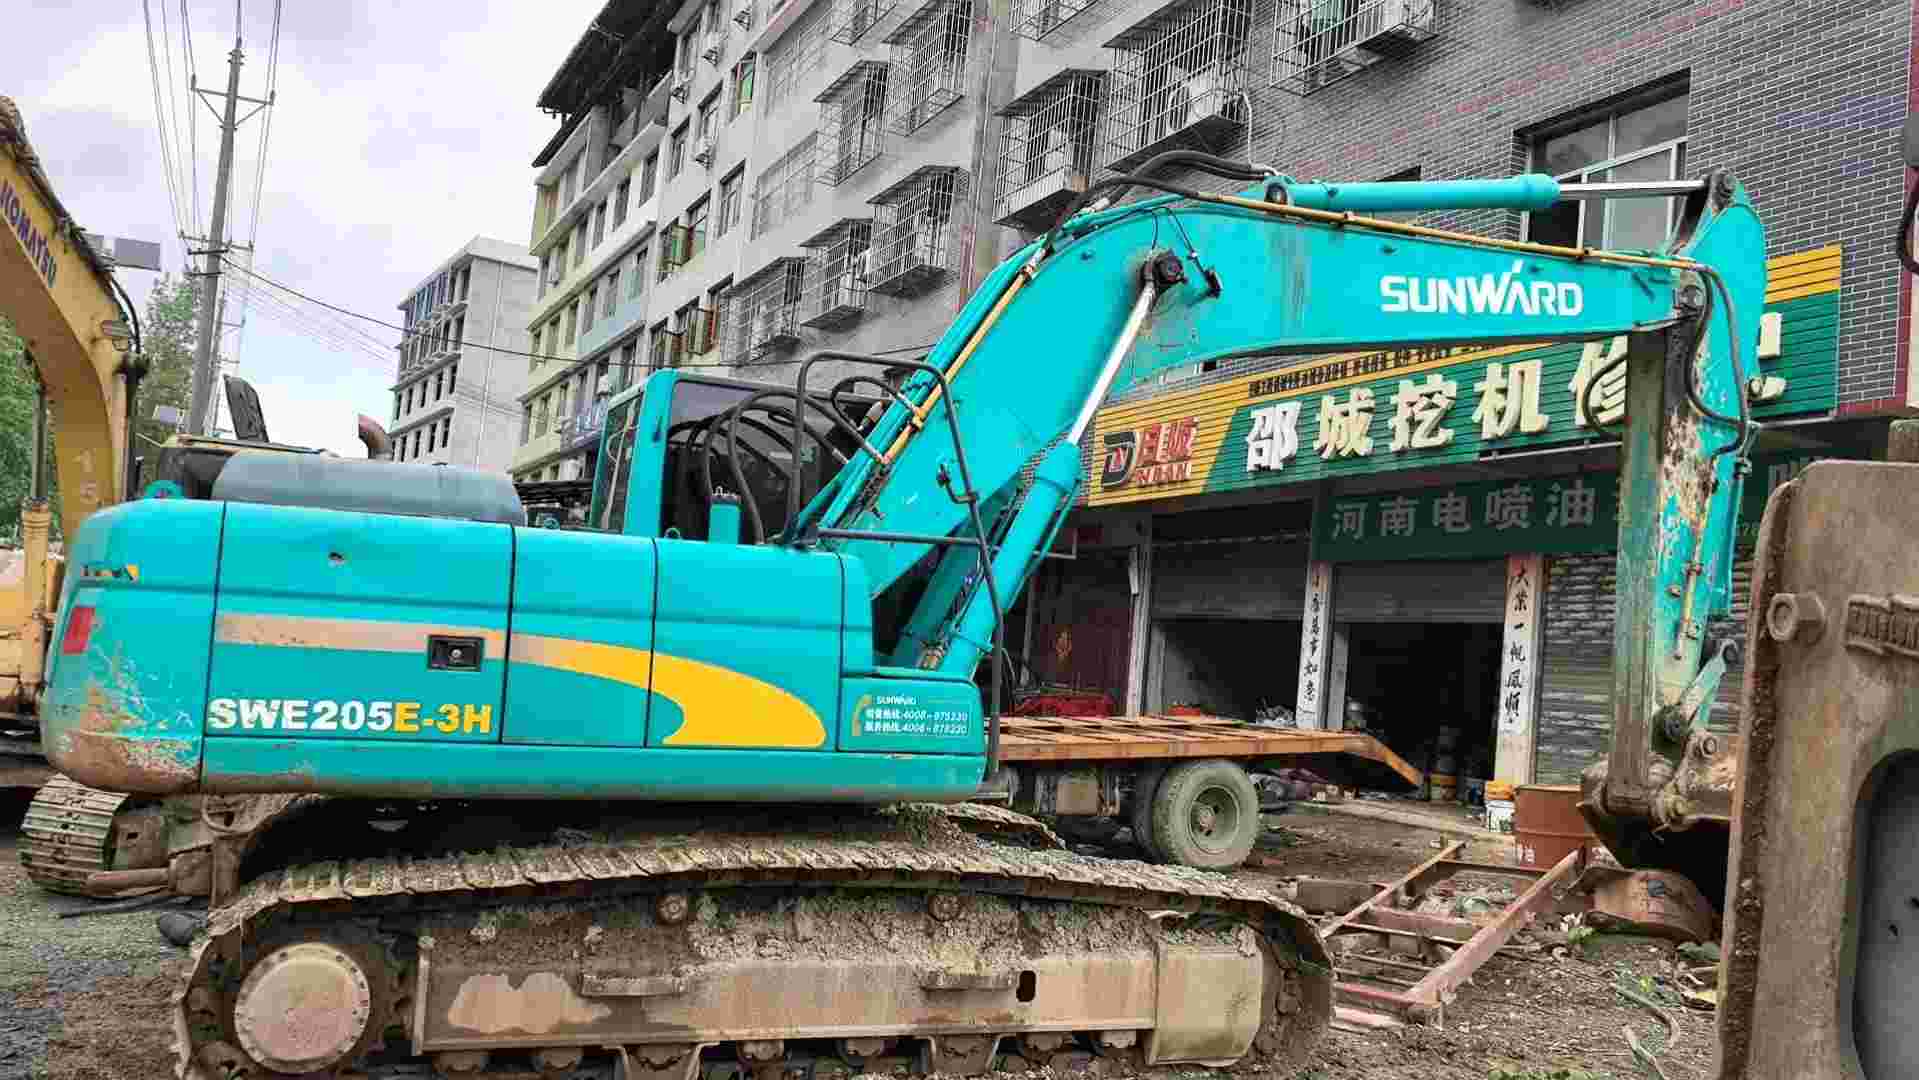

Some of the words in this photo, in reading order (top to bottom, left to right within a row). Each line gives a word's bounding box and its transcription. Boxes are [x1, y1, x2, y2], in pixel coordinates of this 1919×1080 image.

[1379, 259, 1584, 317] SUNWARD
[1331, 480, 1620, 541] 河南电喷油
[207, 697, 494, 734] SWE205E-3H
